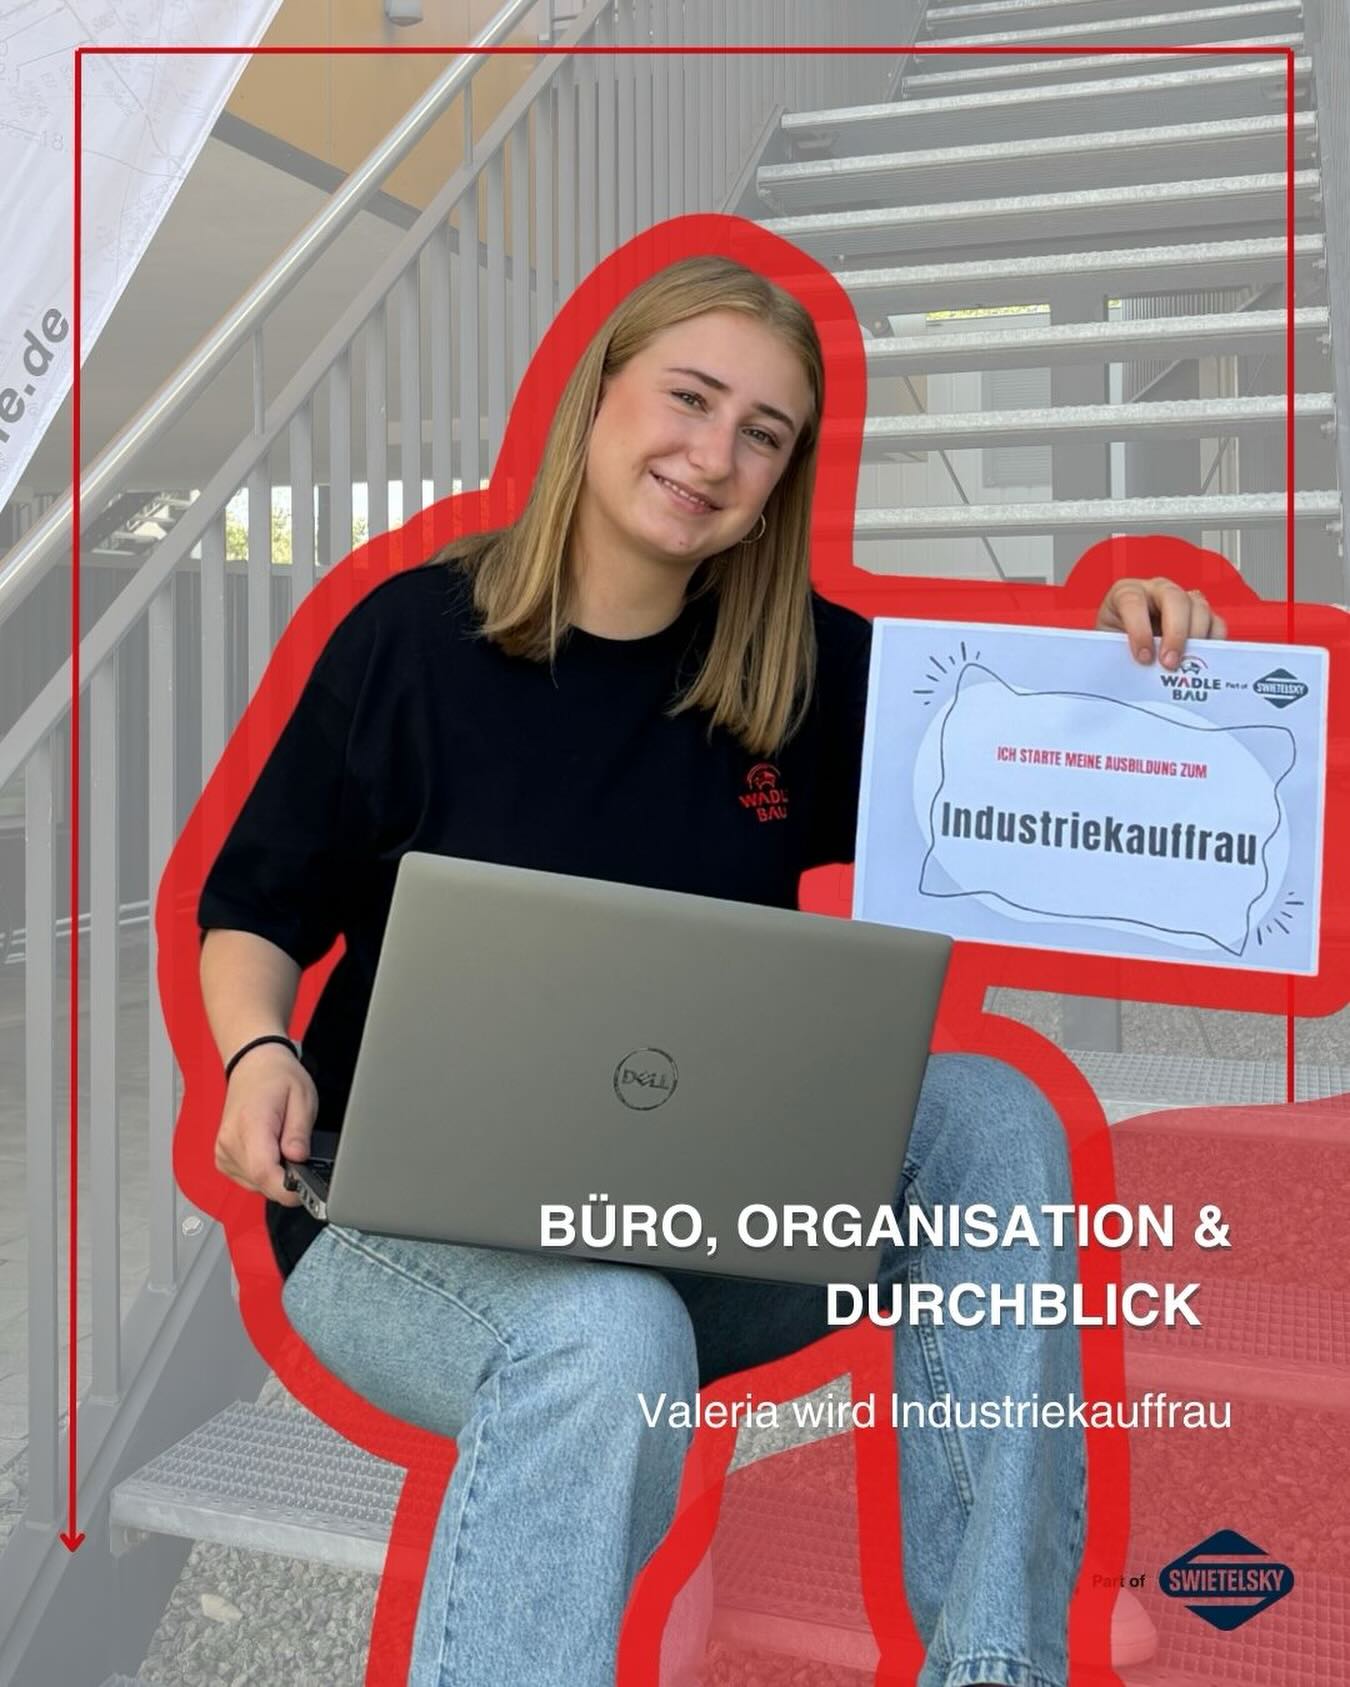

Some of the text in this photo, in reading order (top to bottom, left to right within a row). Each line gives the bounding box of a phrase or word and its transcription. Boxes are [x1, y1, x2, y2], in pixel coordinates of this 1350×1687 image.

[0, 308, 70, 444] e.de
[1160, 675, 1221, 690] WADLE
[1172, 689, 1208, 702] BAU
[997, 746, 1208, 779] ICH STARTE MEINE AUSBILDUNG ZUM
[739, 789, 789, 808] WADL
[942, 802, 1258, 866] Industriekauffrau
[623, 1069, 669, 1091] DELL
